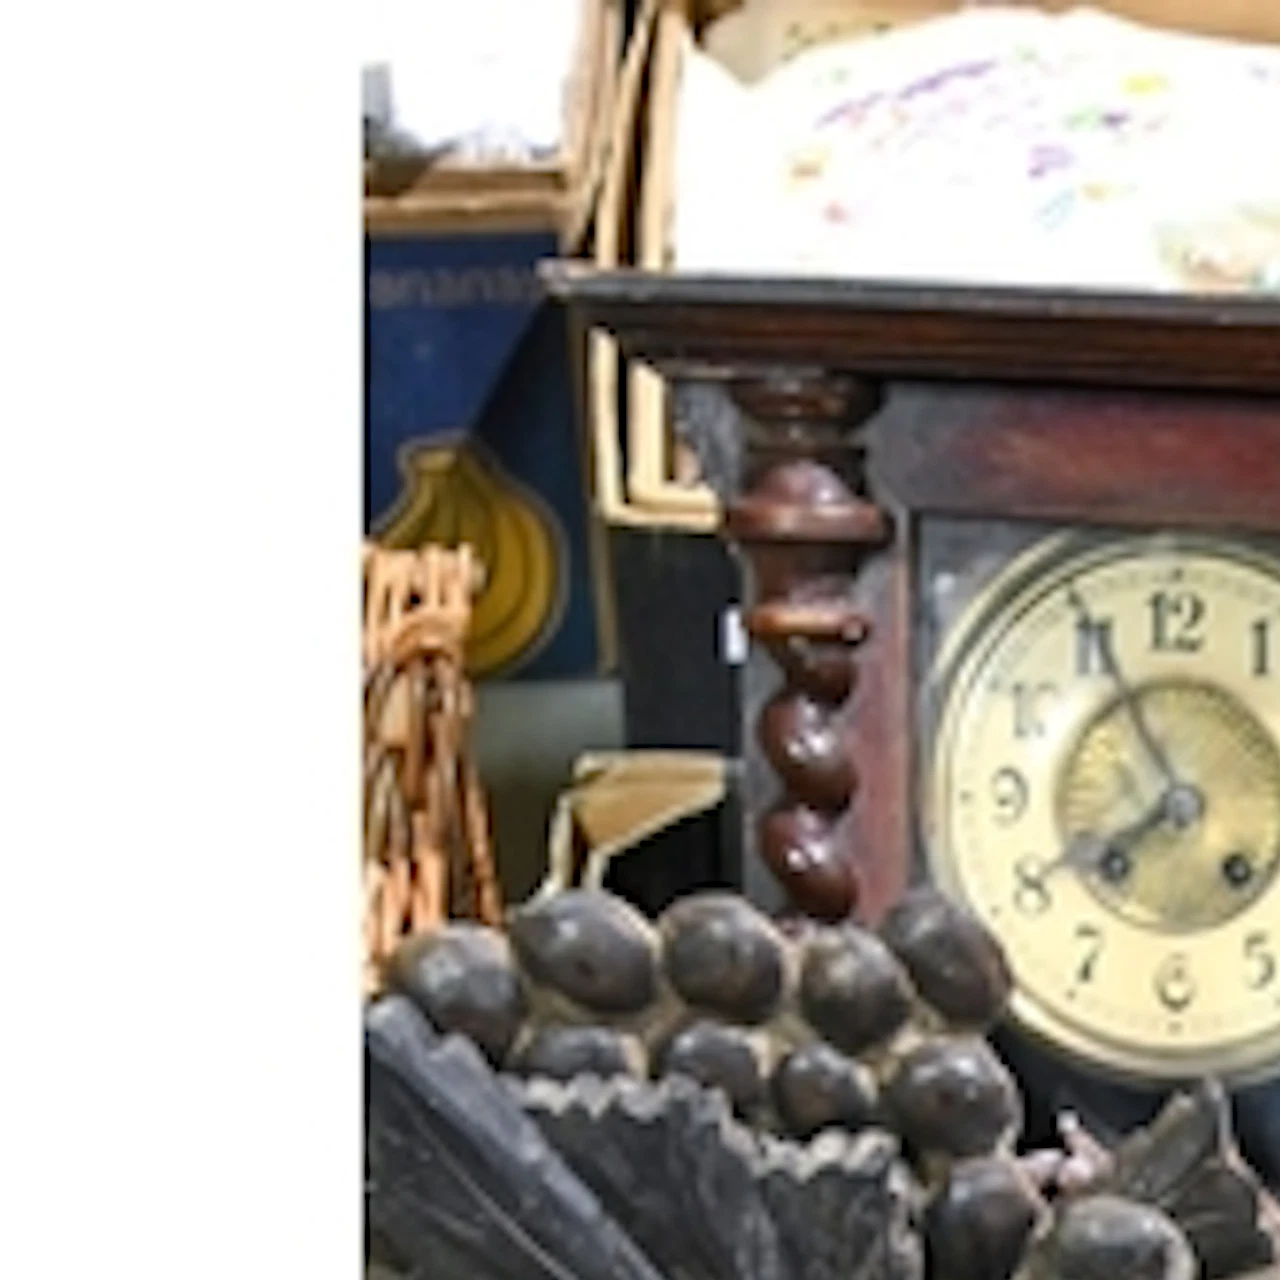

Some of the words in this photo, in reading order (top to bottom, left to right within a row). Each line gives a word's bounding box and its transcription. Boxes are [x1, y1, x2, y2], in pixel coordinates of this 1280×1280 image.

[1146, 591, 1204, 652] 12
[1251, 620, 1271, 677] 1
[990, 768, 1027, 824] 9
[1014, 859, 1051, 915] 8
[1073, 928, 1105, 983] 7
[1155, 955, 1196, 1011] 6
[1243, 936, 1276, 988] 5
